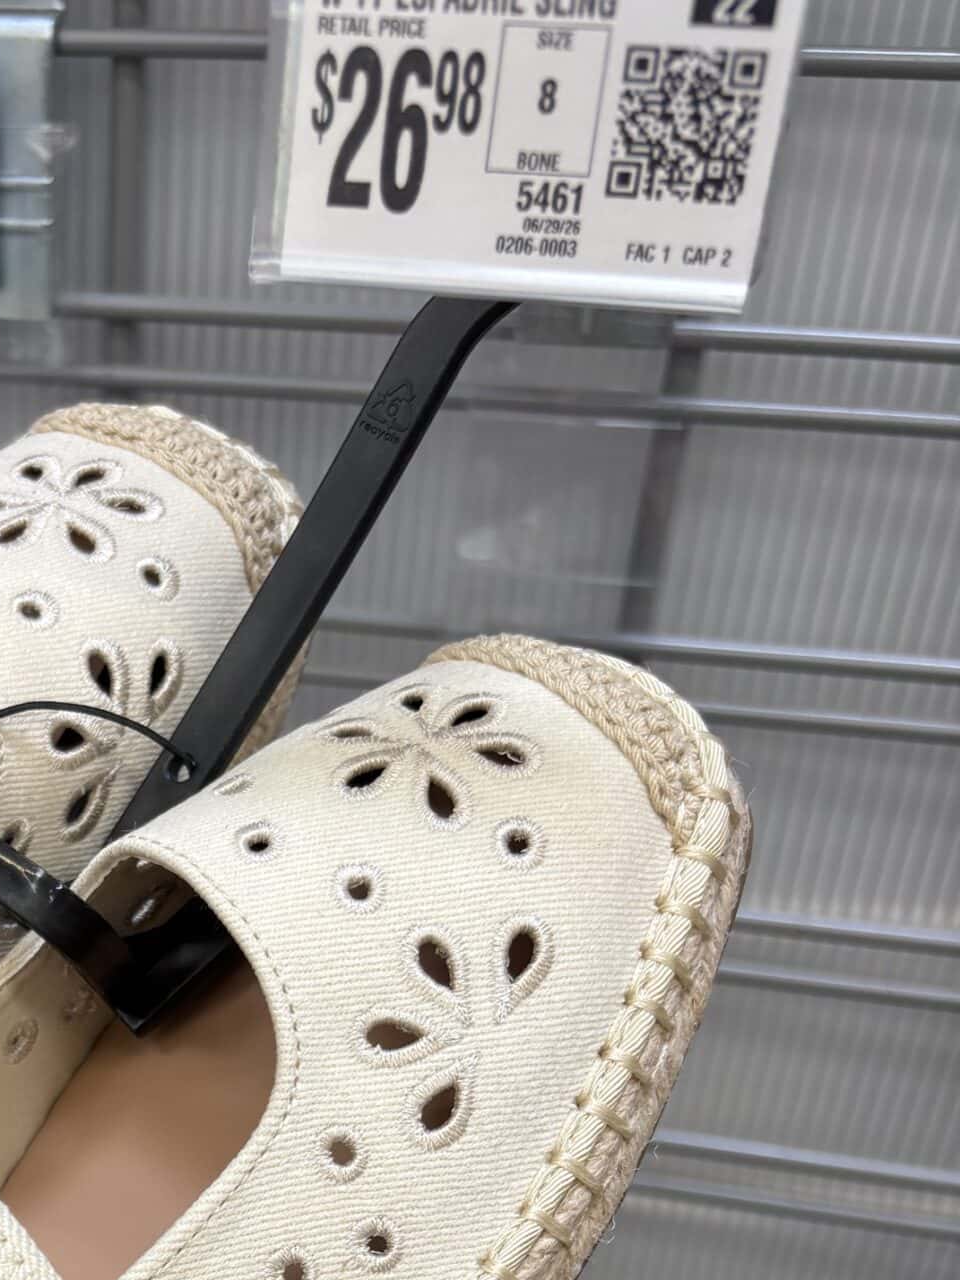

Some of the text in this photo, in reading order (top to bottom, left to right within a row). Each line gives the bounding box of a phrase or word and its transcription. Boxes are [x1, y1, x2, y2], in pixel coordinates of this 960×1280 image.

[317, 15, 426, 40] RETAIL PRICE
[536, 30, 574, 51] SIZE
[537, 79, 558, 115] 8
[517, 152, 562, 172] BONE
[516, 180, 584, 215] 5461
[522, 216, 581, 235] 06/29/26
[495, 235, 578, 258] 0206-0003
[625, 242, 733, 267] FAC 1 CAP 2
